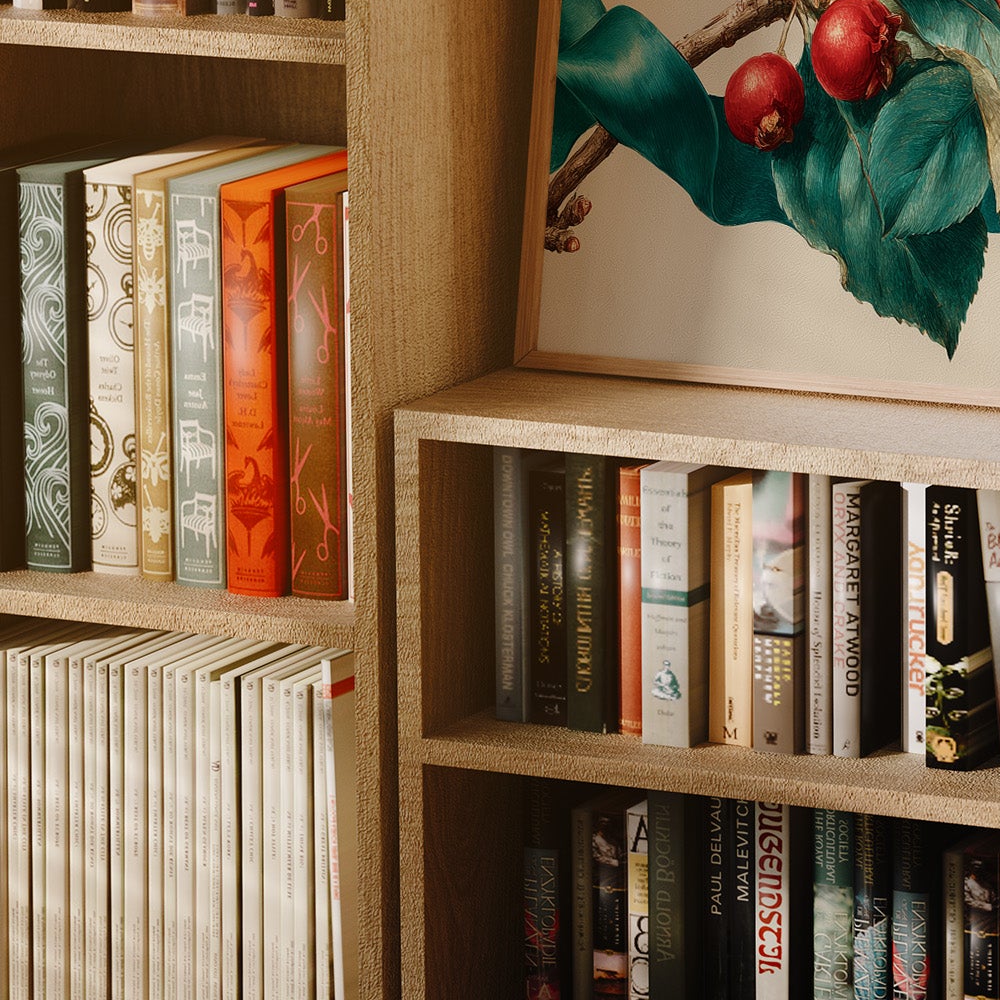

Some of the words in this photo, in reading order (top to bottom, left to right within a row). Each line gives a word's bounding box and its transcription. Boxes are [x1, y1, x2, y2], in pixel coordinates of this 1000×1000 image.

[834, 492, 845, 541] ORYX
[834, 552, 845, 594] AND
[847, 493, 859, 605] MARGARET
[834, 602, 845, 668] CRAKE
[847, 613, 859, 696] ATWOOD
[711, 877, 722, 915] PAUL
